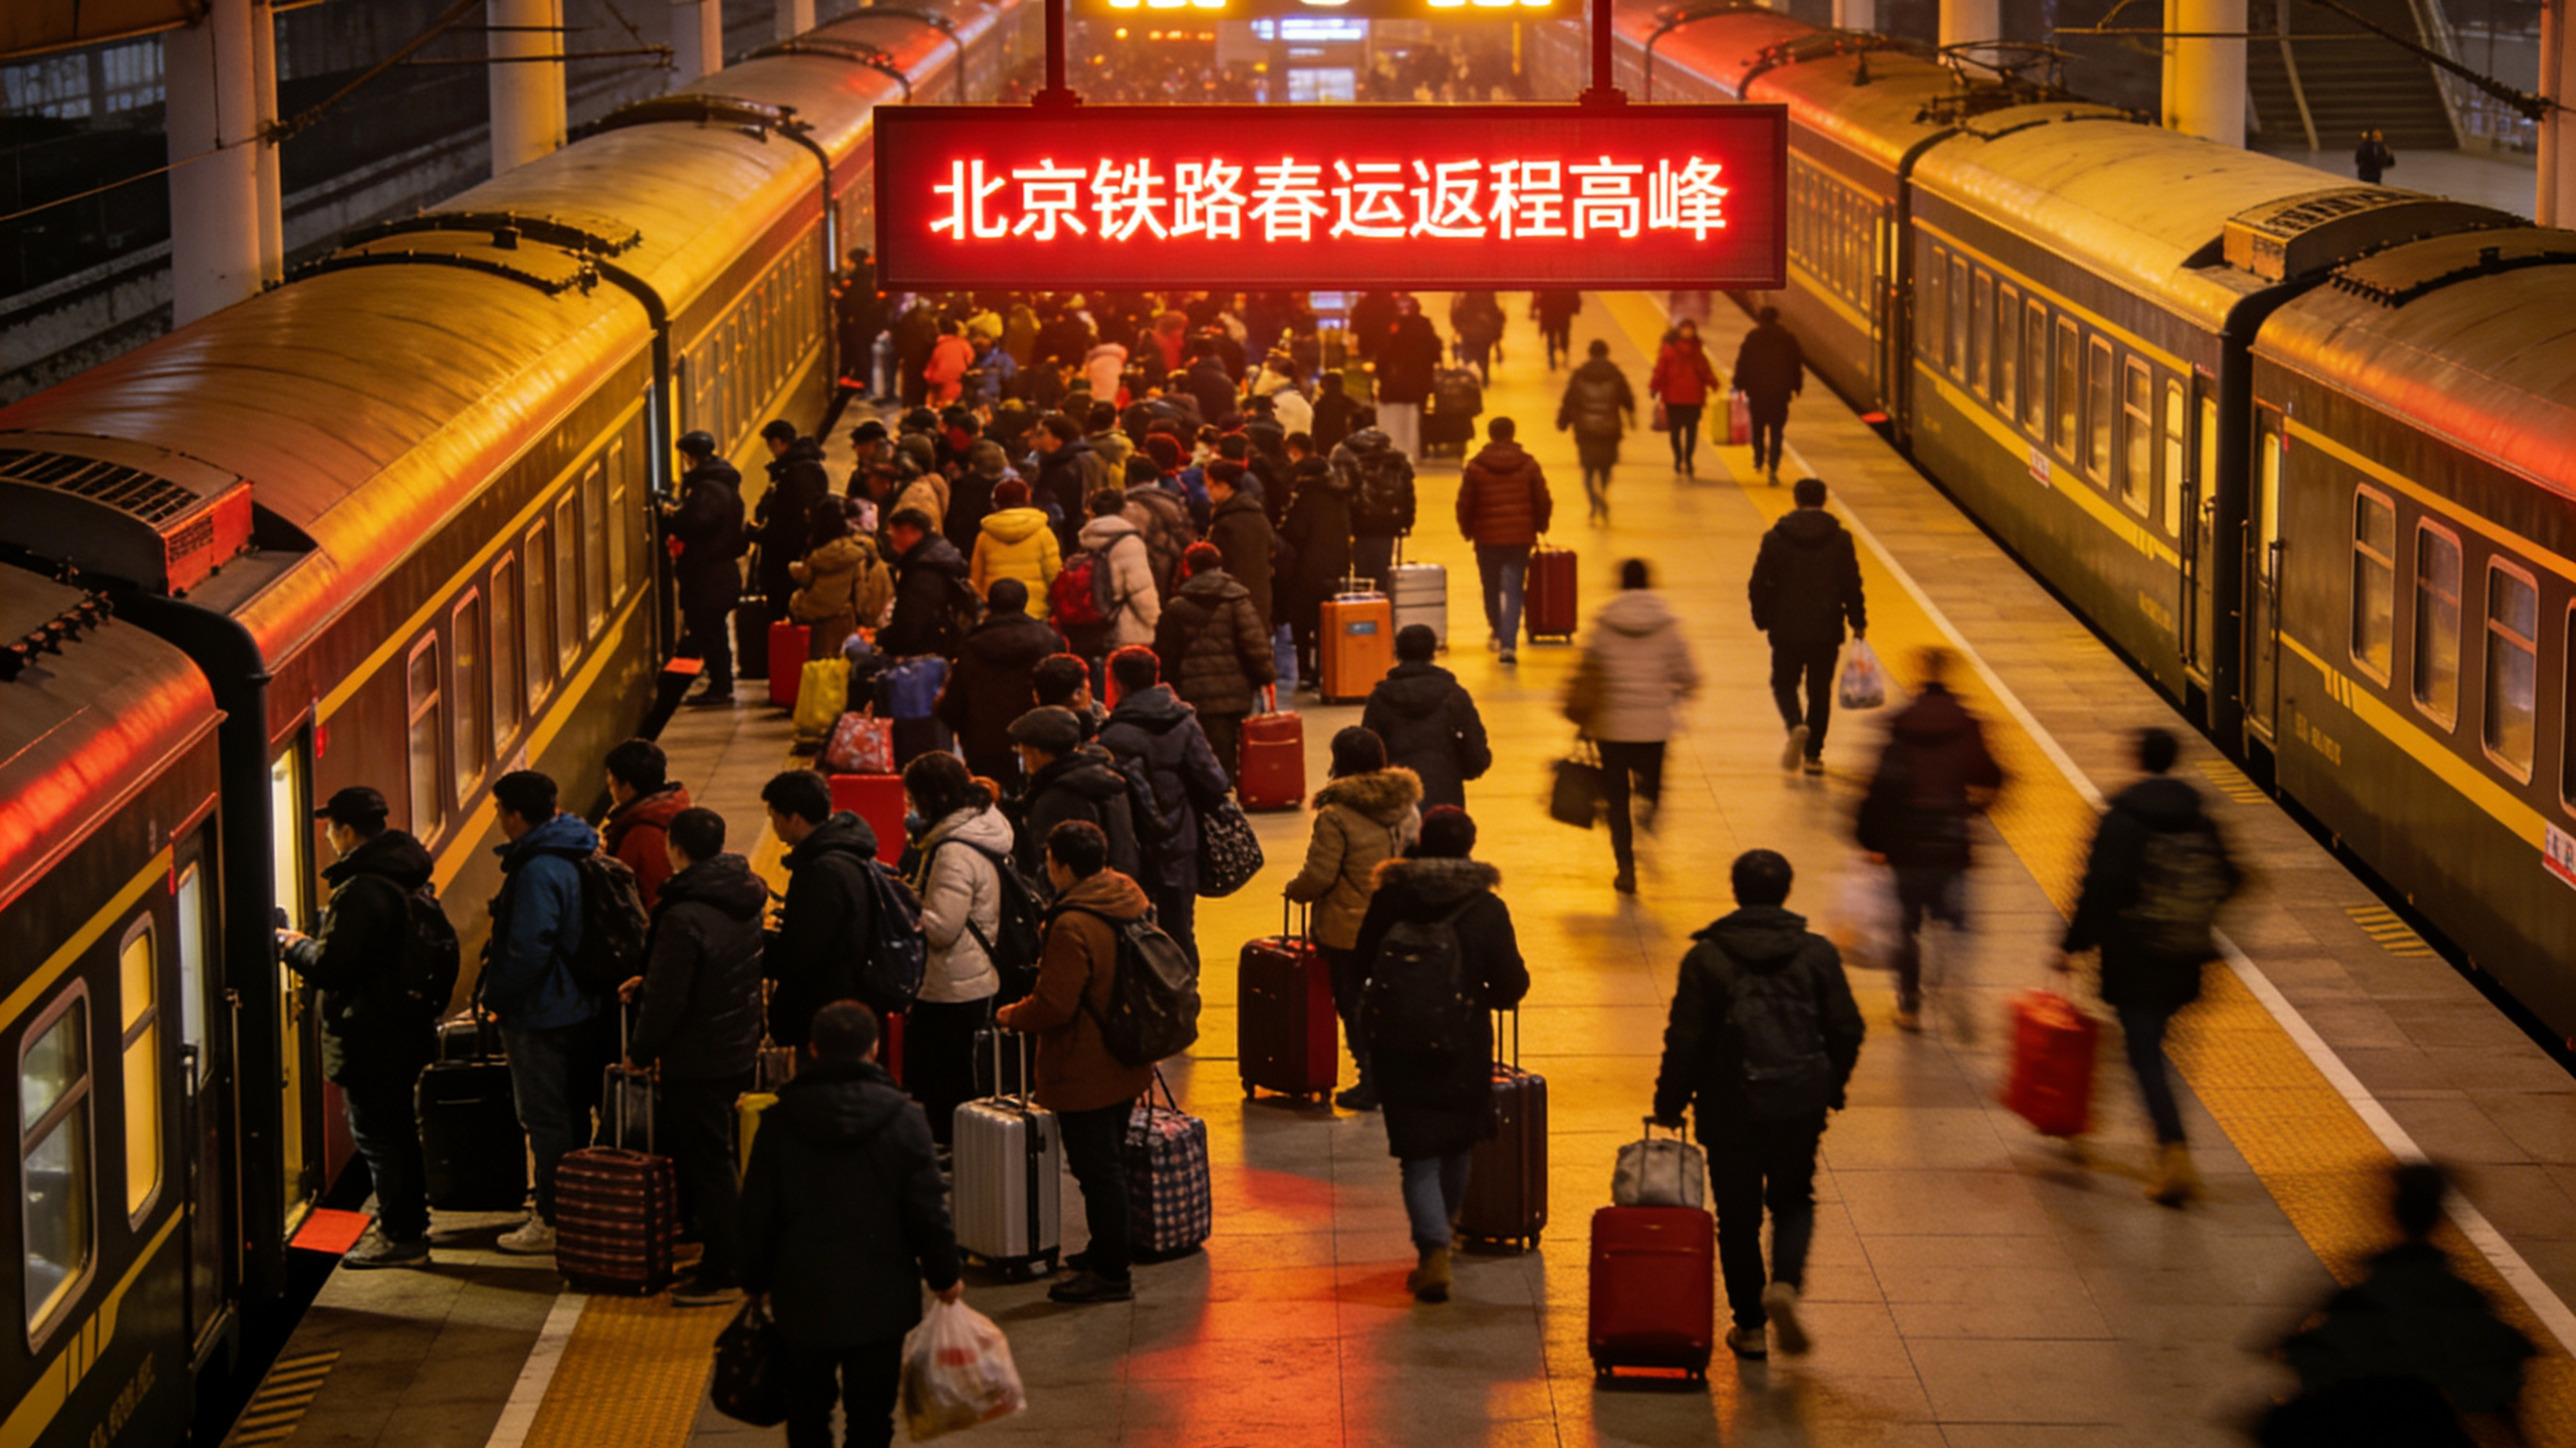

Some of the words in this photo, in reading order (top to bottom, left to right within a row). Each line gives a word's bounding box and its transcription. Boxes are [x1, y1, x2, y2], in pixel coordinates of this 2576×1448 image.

[929, 156, 1729, 241] 北京铁路春运返程高峰
